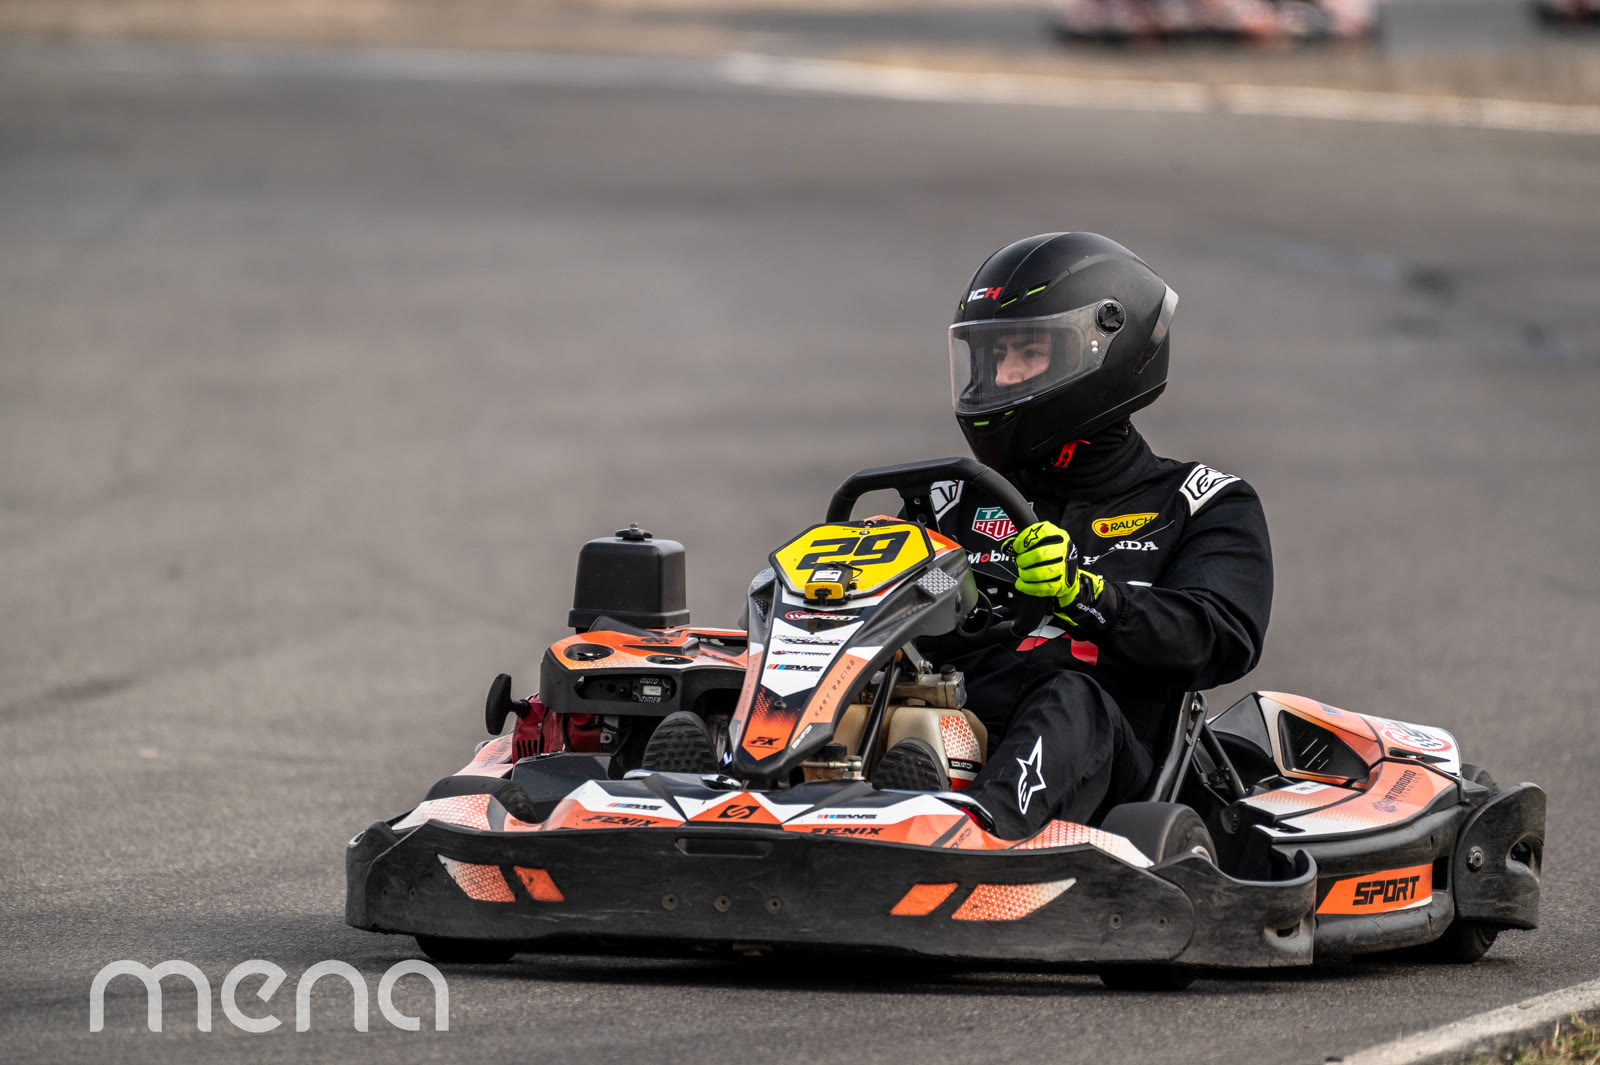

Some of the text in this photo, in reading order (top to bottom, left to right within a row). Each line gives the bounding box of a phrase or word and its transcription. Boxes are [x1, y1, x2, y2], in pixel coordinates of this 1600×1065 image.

[981, 508, 1009, 520] TA
[975, 520, 1015, 539] HEUE
[1110, 516, 1153, 532] RAUCH
[796, 530, 911, 571] 29
[1083, 540, 1159, 566] HNDA
[582, 815, 660, 828] FENIX
[1352, 875, 1421, 906] SPORT
